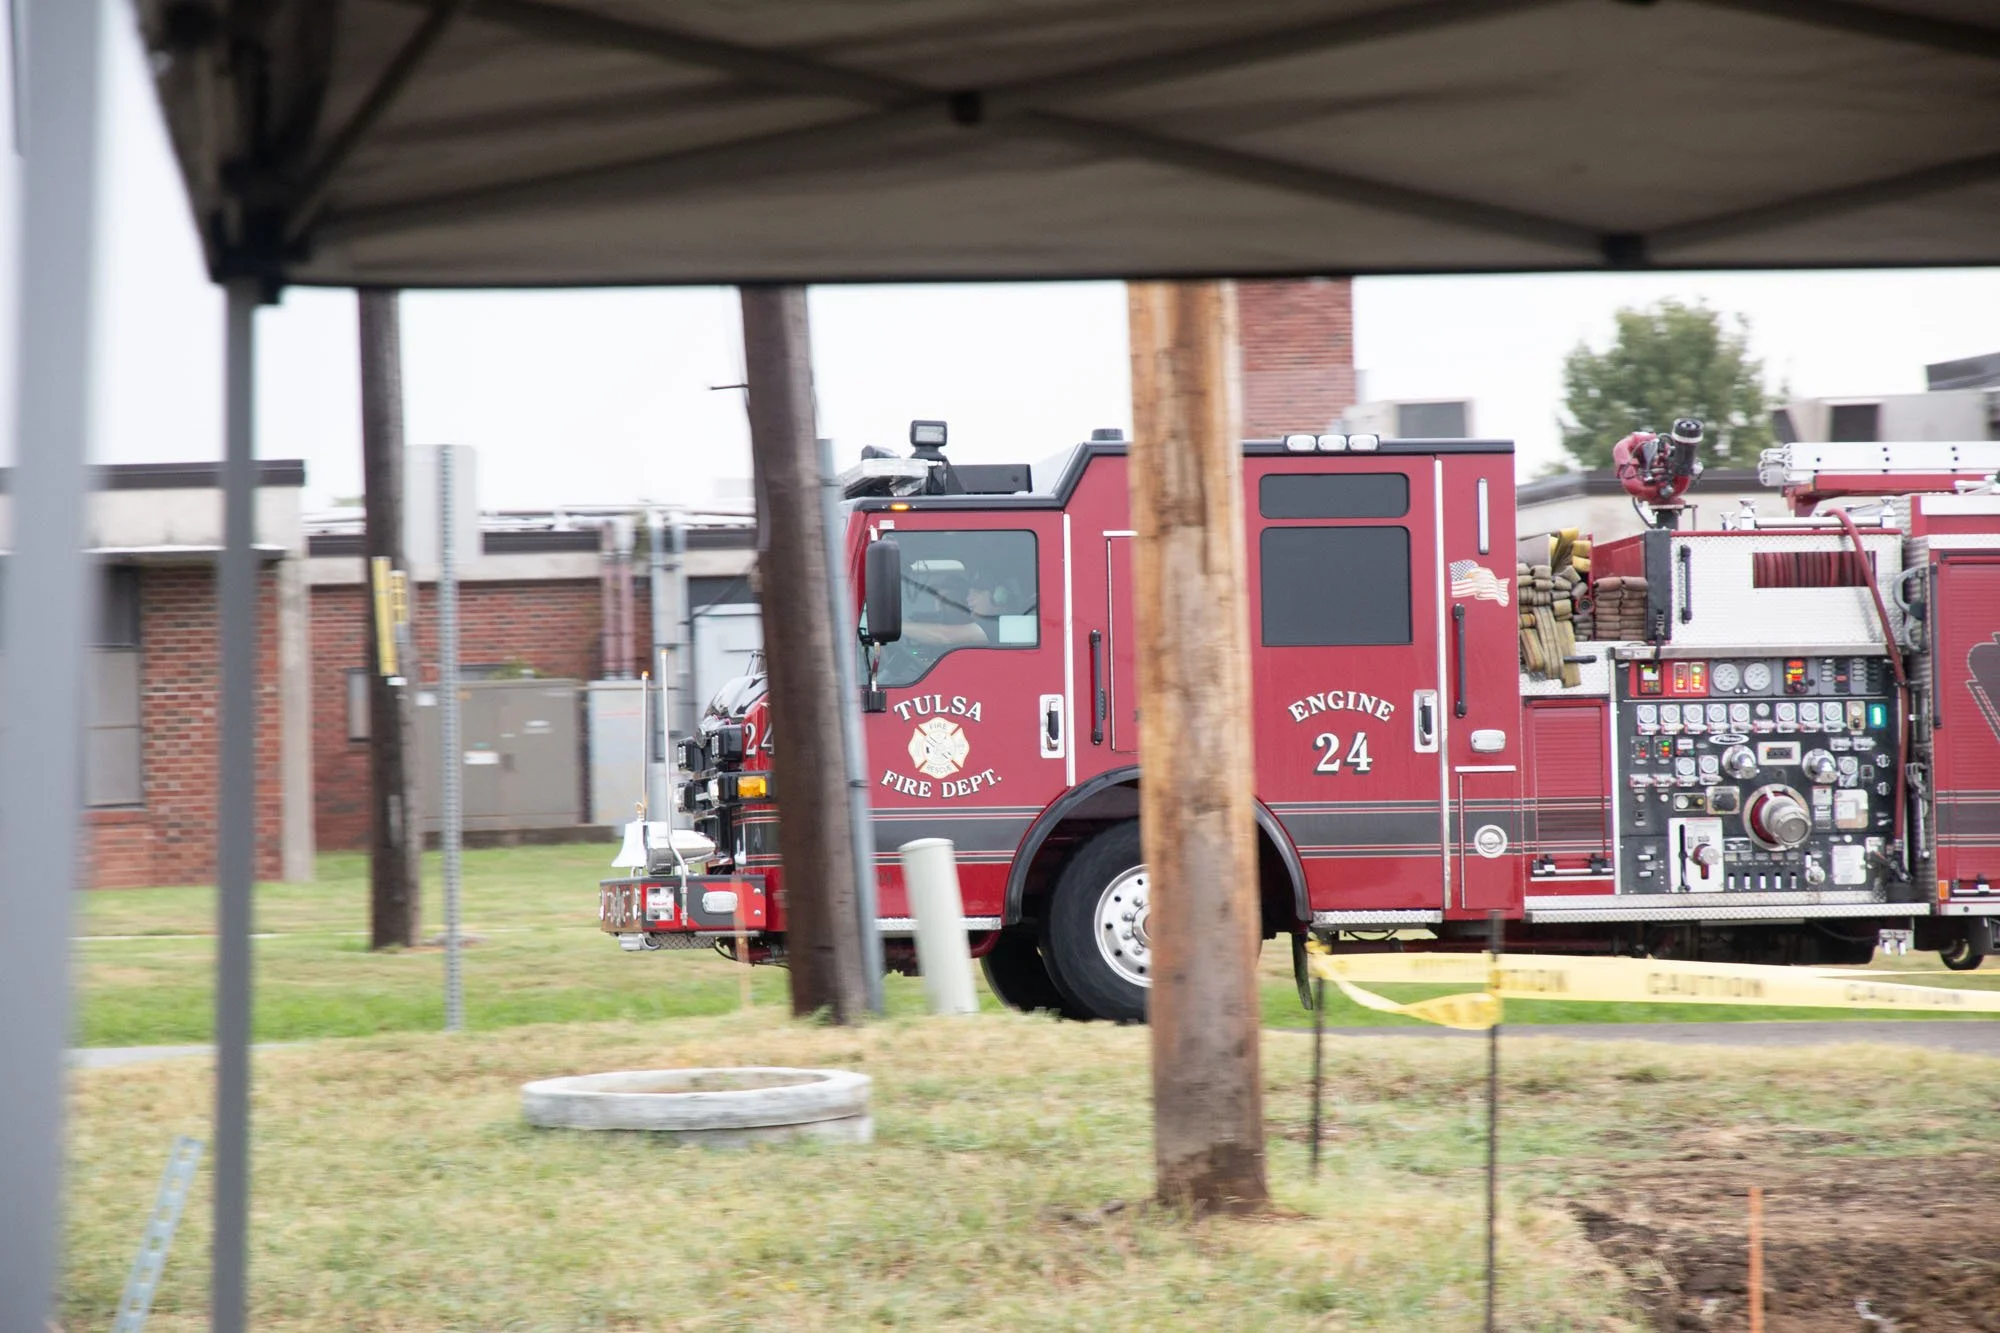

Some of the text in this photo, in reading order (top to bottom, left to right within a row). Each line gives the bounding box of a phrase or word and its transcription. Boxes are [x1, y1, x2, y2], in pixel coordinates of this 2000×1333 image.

[893, 694, 982, 722] TULSA
[1288, 690, 1395, 722] ENGINE
[745, 722, 775, 756] 24
[929, 722, 947, 730] FIRE
[1314, 731, 1374, 773] 24
[880, 768, 1003, 798] FIRE DEPT.
[1647, 972, 1767, 998] CAUTION
